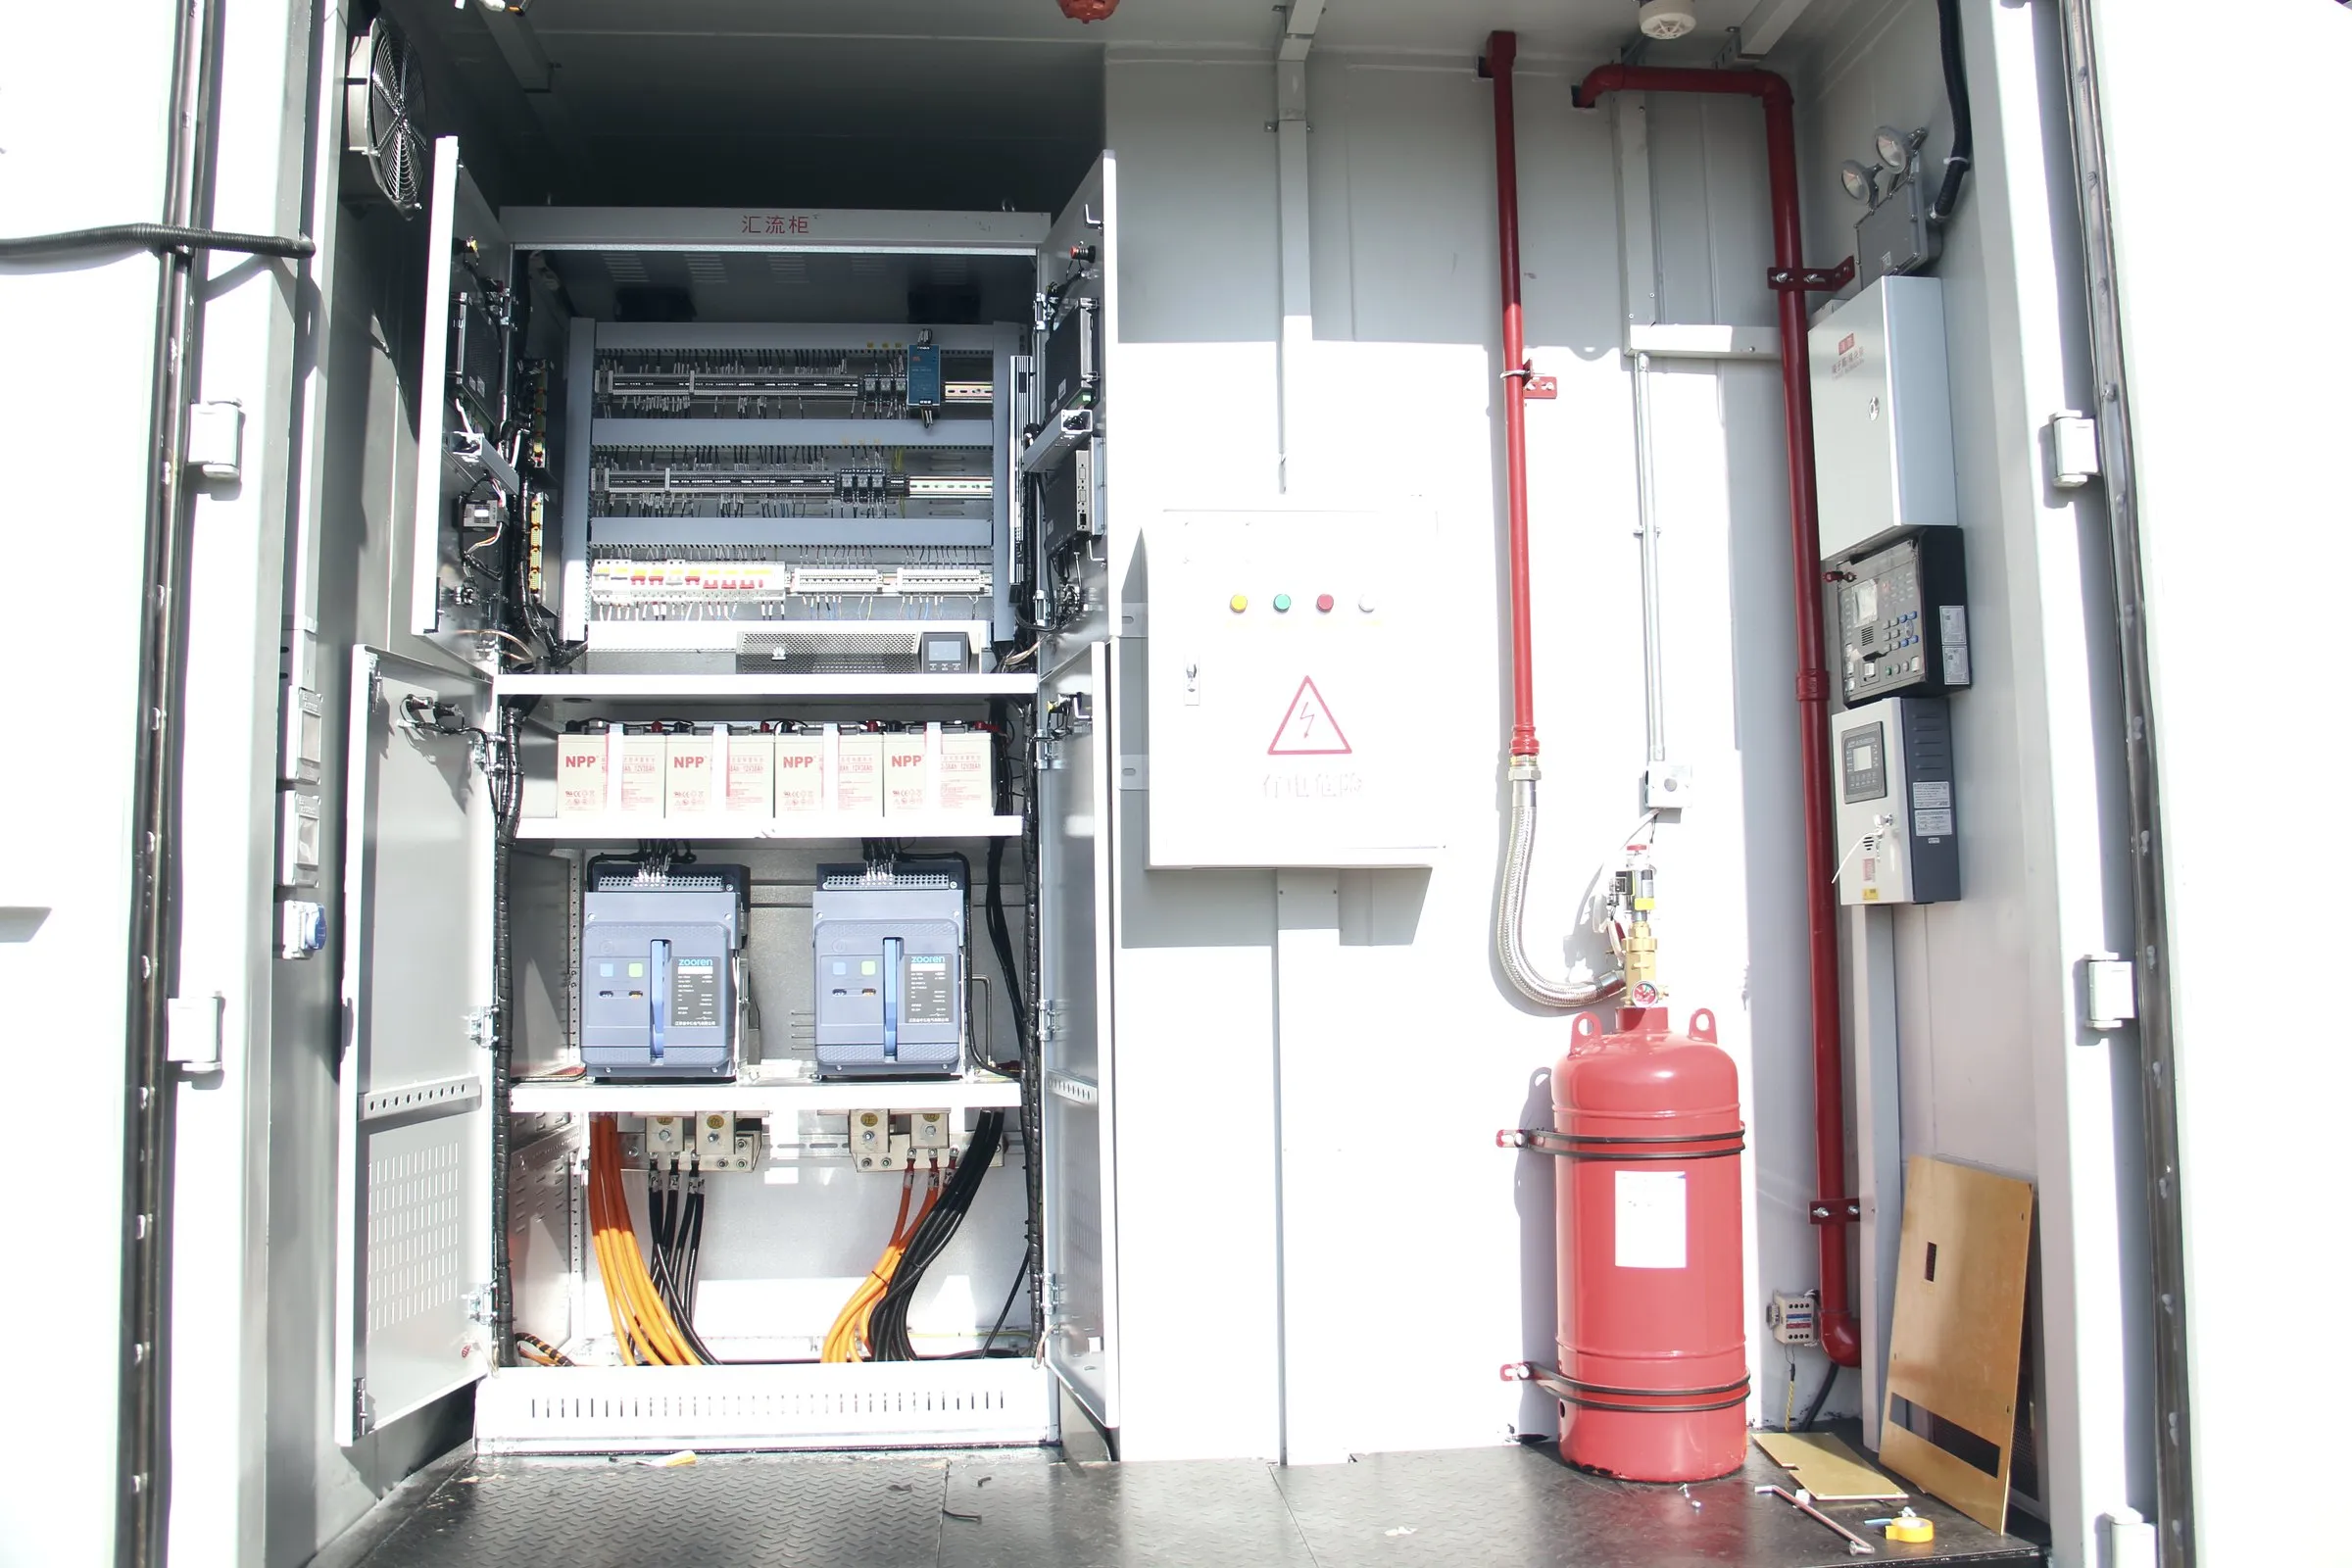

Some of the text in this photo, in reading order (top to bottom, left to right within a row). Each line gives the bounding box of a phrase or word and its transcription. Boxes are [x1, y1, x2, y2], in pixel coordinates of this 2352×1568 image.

[741, 215, 809, 234] 汇流柜
[565, 756, 597, 768] NPP
[673, 756, 705, 768] NPP
[783, 756, 813, 768] NPP
[891, 755, 922, 767] NPP
